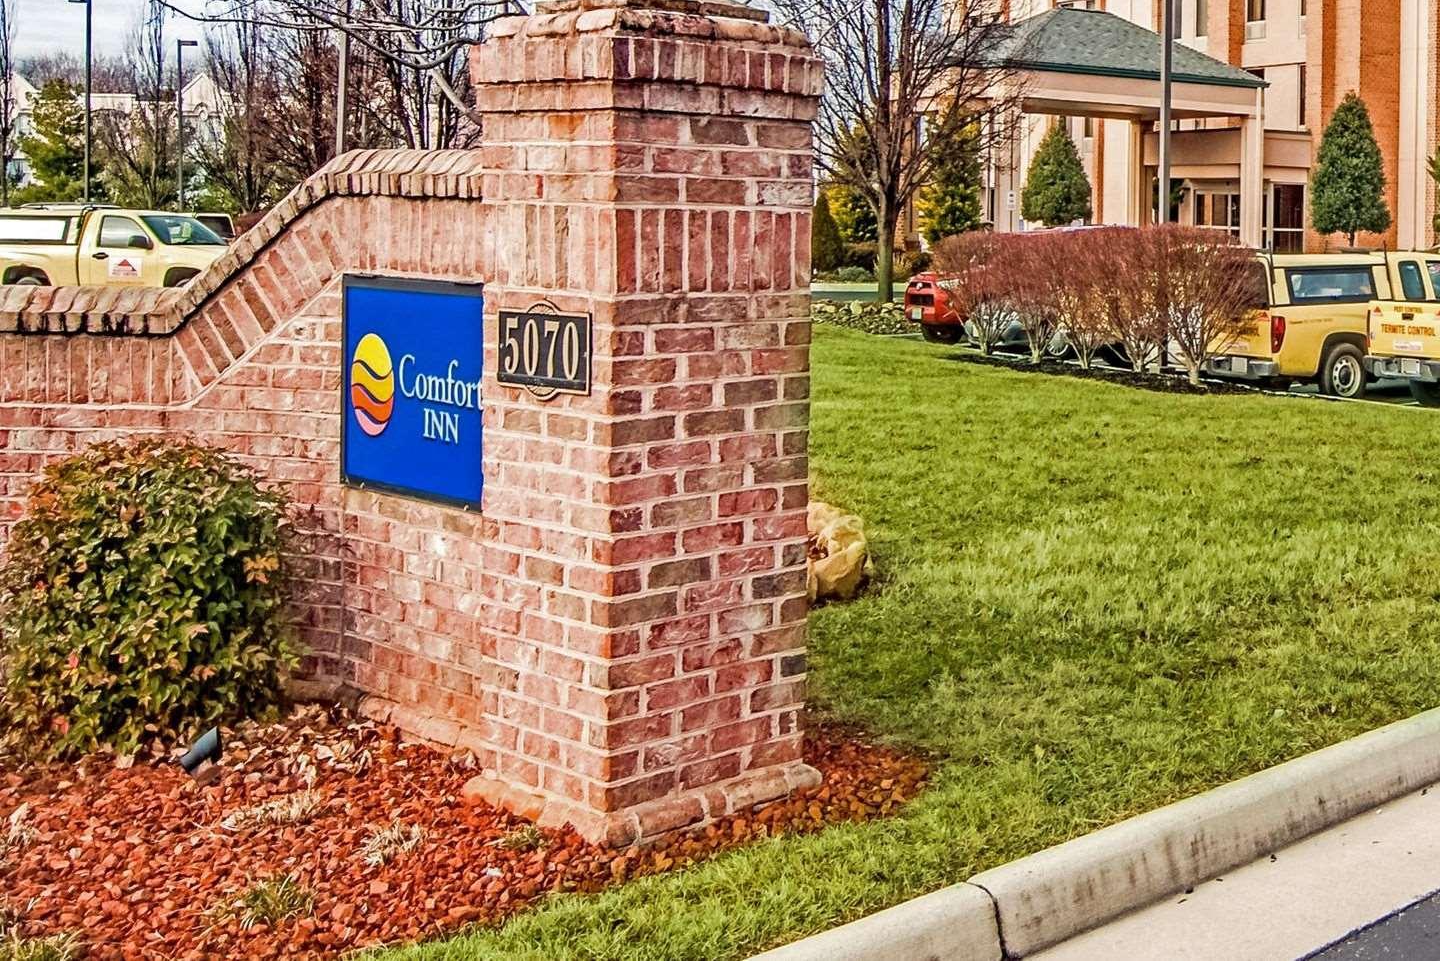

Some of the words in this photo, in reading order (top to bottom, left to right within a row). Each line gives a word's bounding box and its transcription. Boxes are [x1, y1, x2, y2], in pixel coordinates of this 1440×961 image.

[504, 316, 580, 381] 5070
[1381, 323, 1406, 335] TERMITE
[1407, 325, 1437, 337] CONTROL
[423, 408, 460, 445] INN
